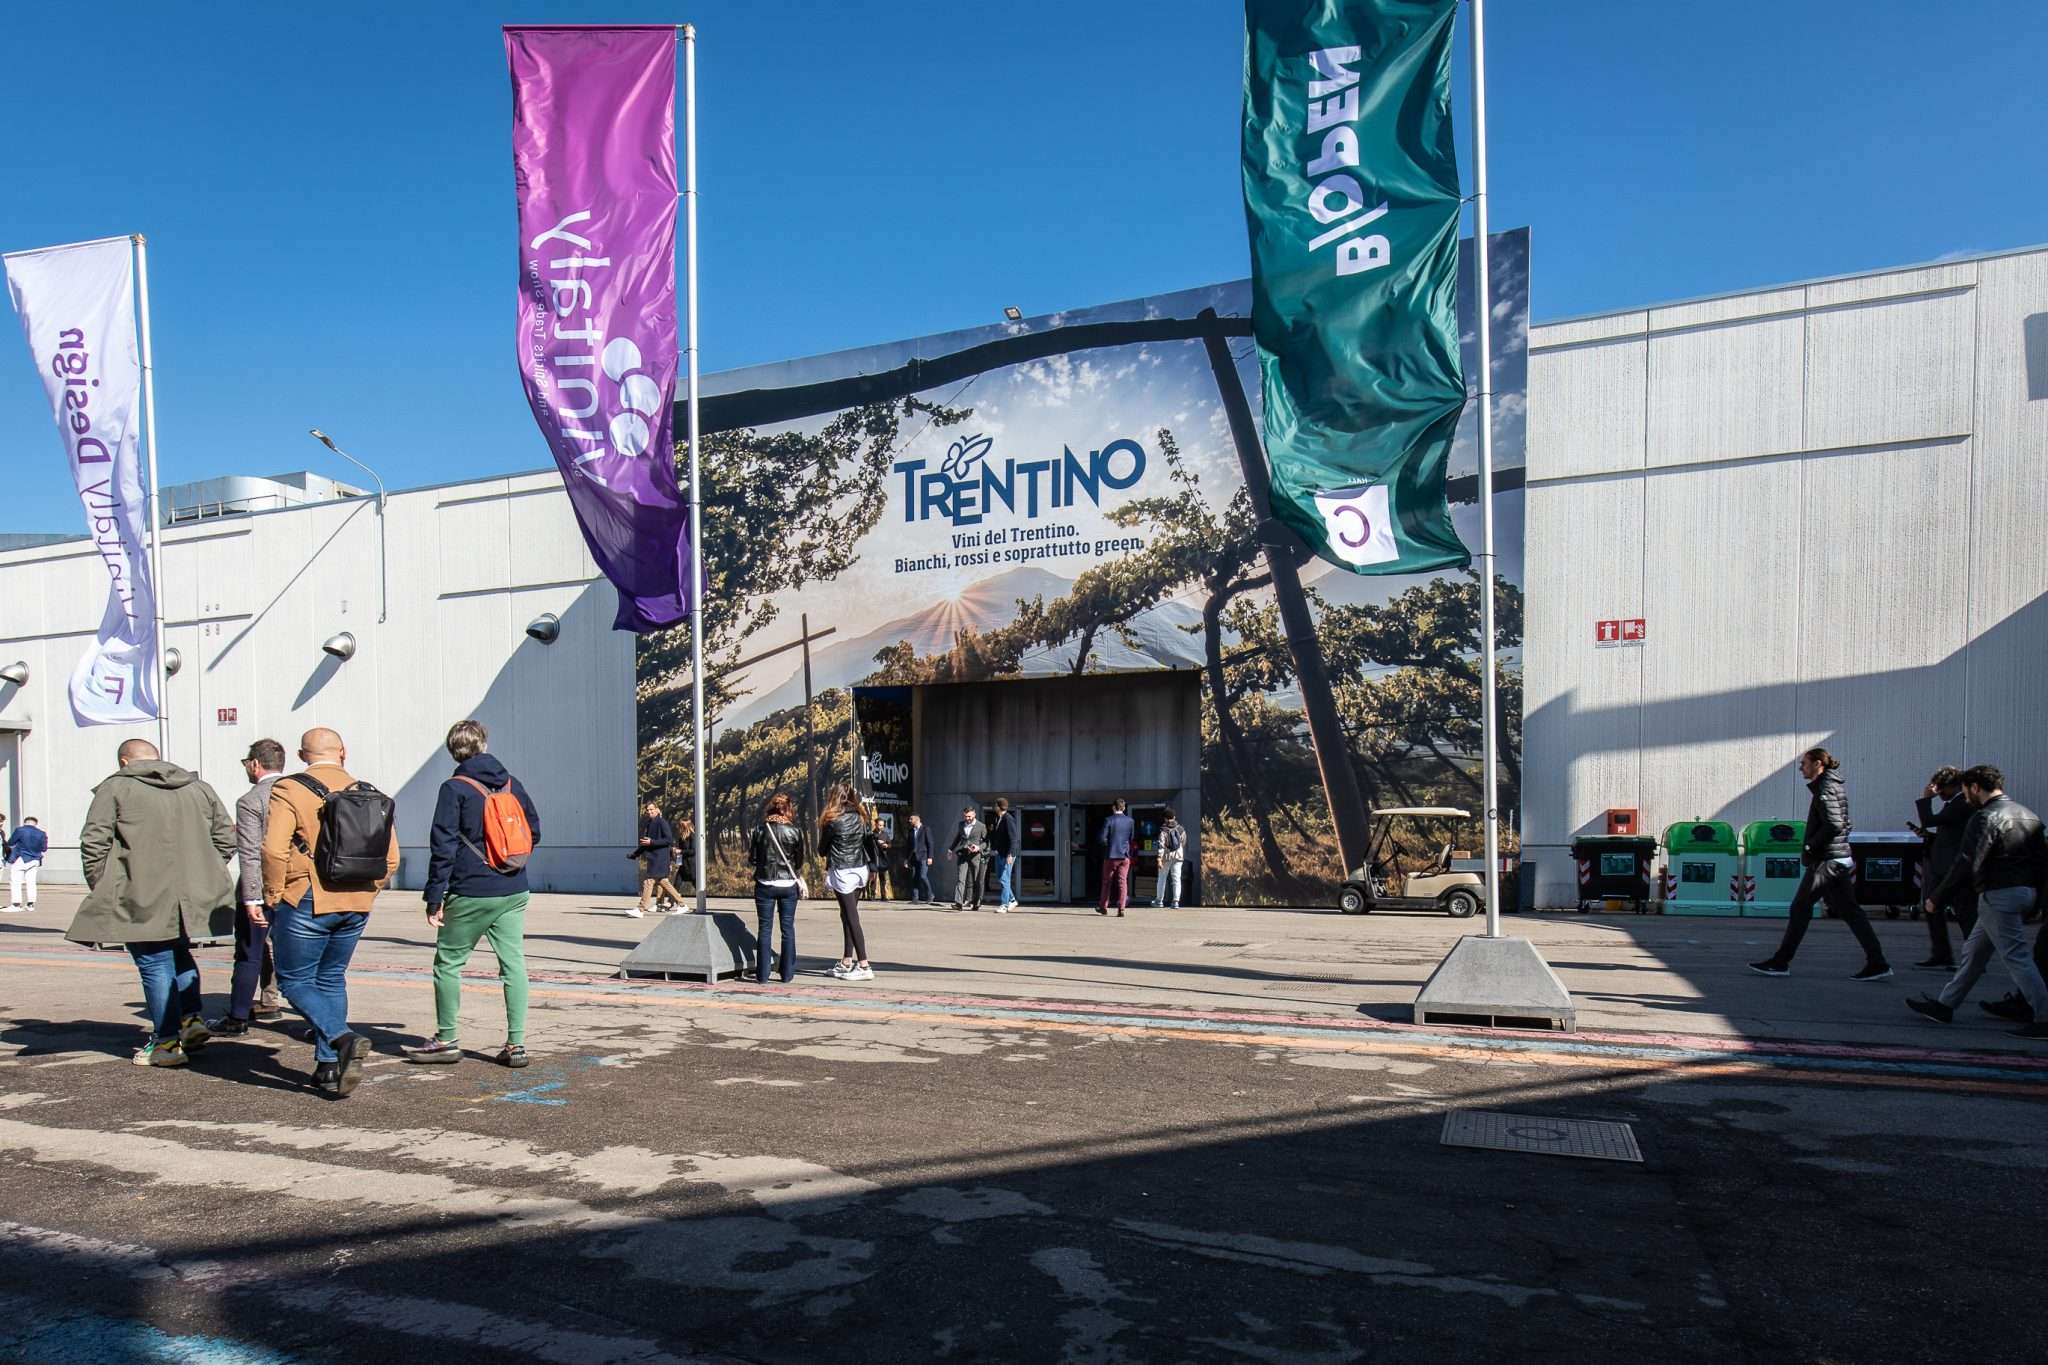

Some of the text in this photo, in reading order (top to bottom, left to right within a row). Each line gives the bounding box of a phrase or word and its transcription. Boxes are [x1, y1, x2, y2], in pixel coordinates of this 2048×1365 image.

[894, 438, 1146, 526] TRENTINO
[952, 523, 1079, 549] Vini del Trentino.
[894, 553, 951, 573] Bianchi,
[955, 549, 988, 566] rossi
[993, 551, 1001, 562] e
[1005, 540, 1090, 563] soprattutto
[861, 756, 909, 784] TRENTINO
